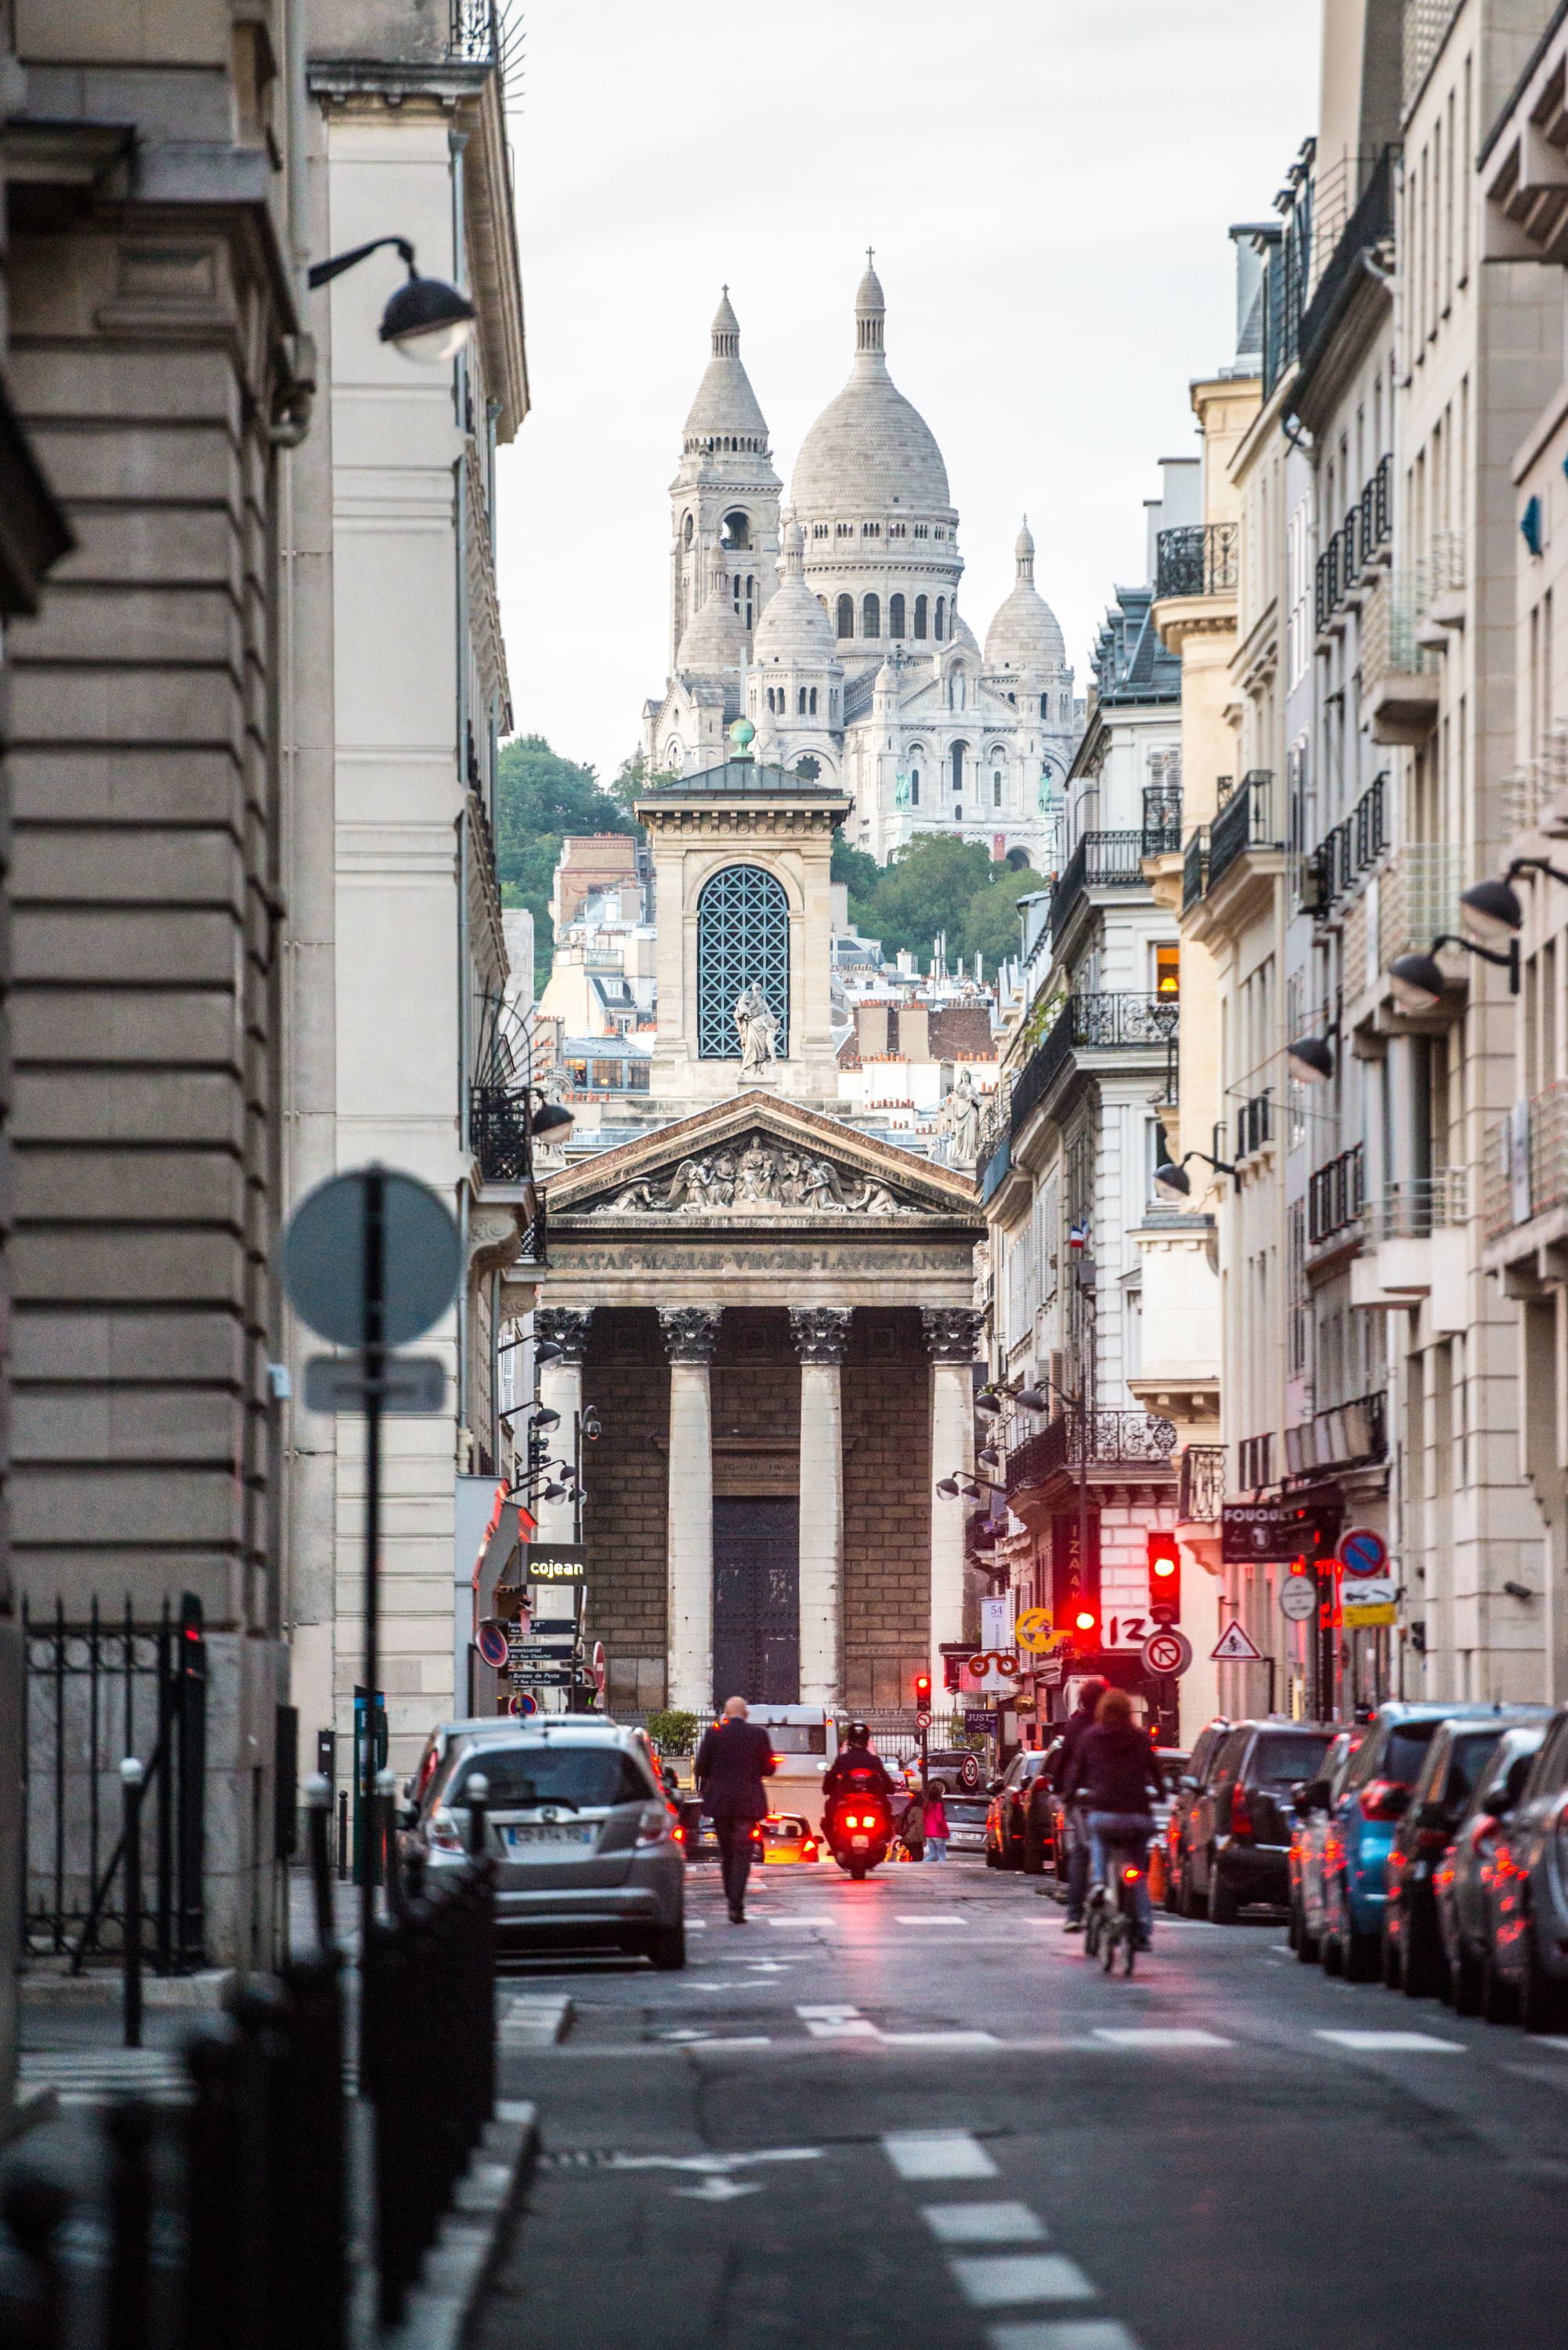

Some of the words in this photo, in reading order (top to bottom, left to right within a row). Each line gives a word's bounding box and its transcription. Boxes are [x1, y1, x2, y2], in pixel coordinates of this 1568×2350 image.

[548, 1252, 632, 1269] BEATAE
[641, 1252, 724, 1269] MARIAE
[732, 1252, 812, 1269] VIRGINI
[529, 1559, 583, 1578] cojean
[990, 1605, 1003, 1615] 54
[965, 1763, 975, 1777] 30
